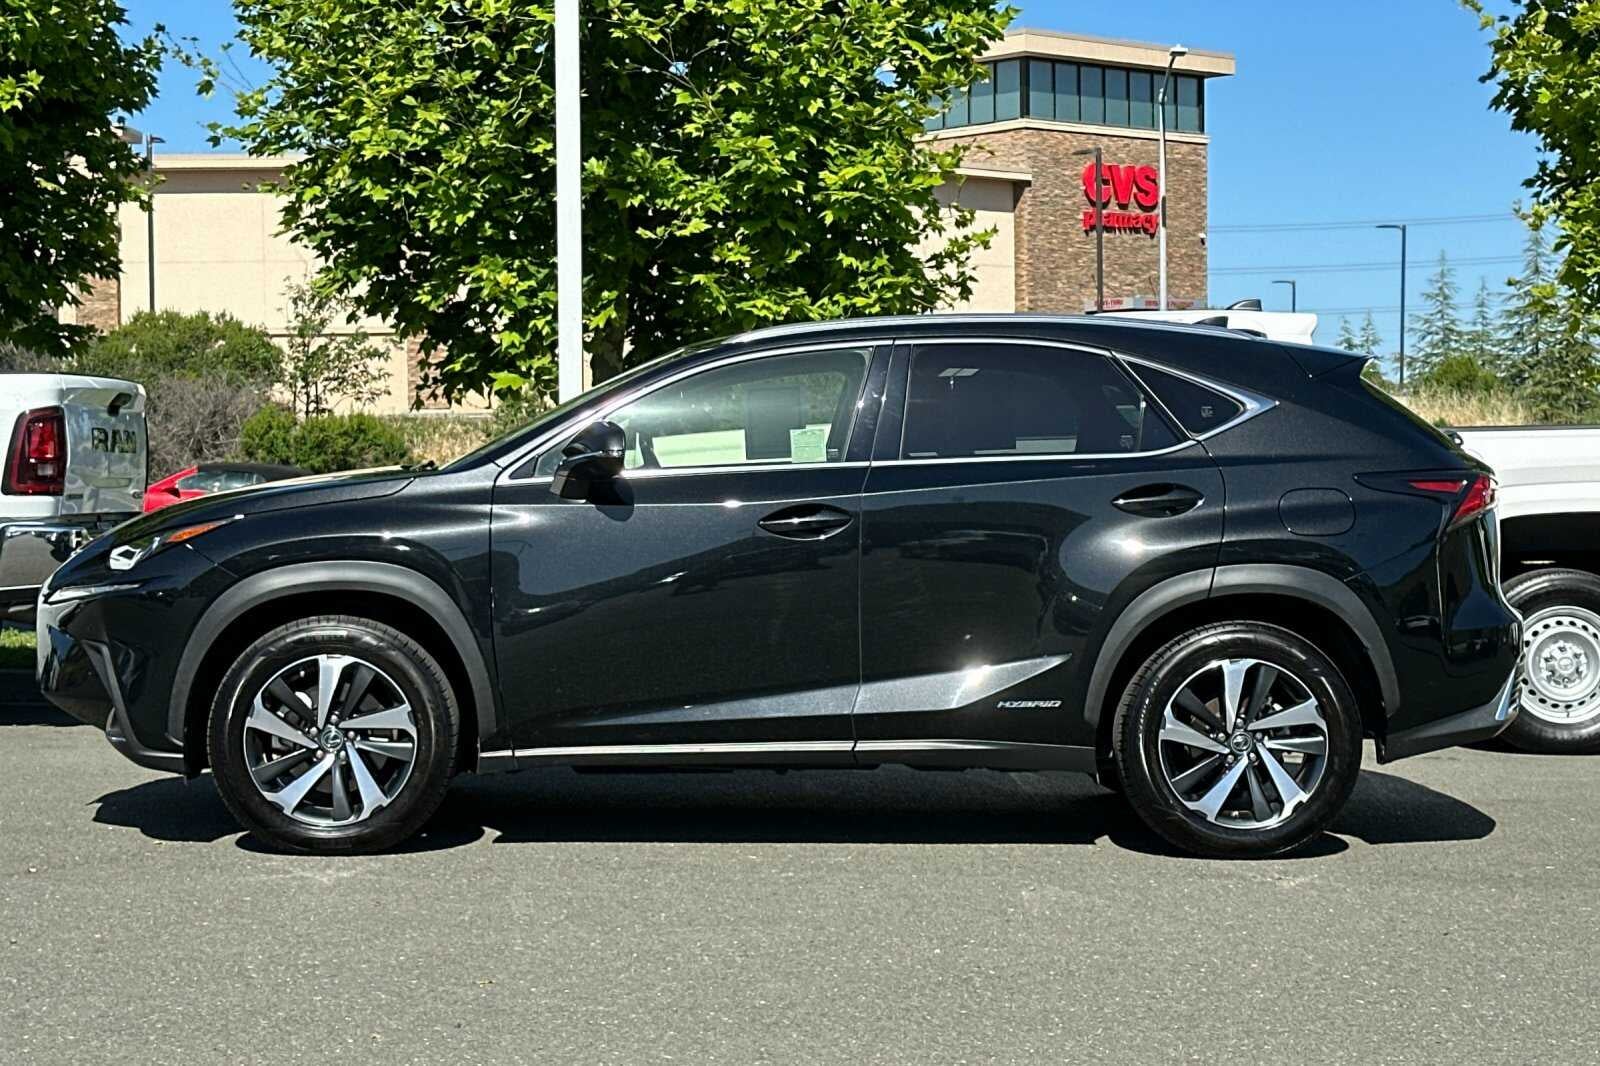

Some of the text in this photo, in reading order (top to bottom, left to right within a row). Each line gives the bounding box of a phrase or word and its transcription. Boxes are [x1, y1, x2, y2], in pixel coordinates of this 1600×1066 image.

[1082, 162, 1159, 212] CVS
[1082, 210, 1159, 239] parmacy
[91, 427, 137, 454] RAM
[996, 700, 1062, 708] HYBRID
